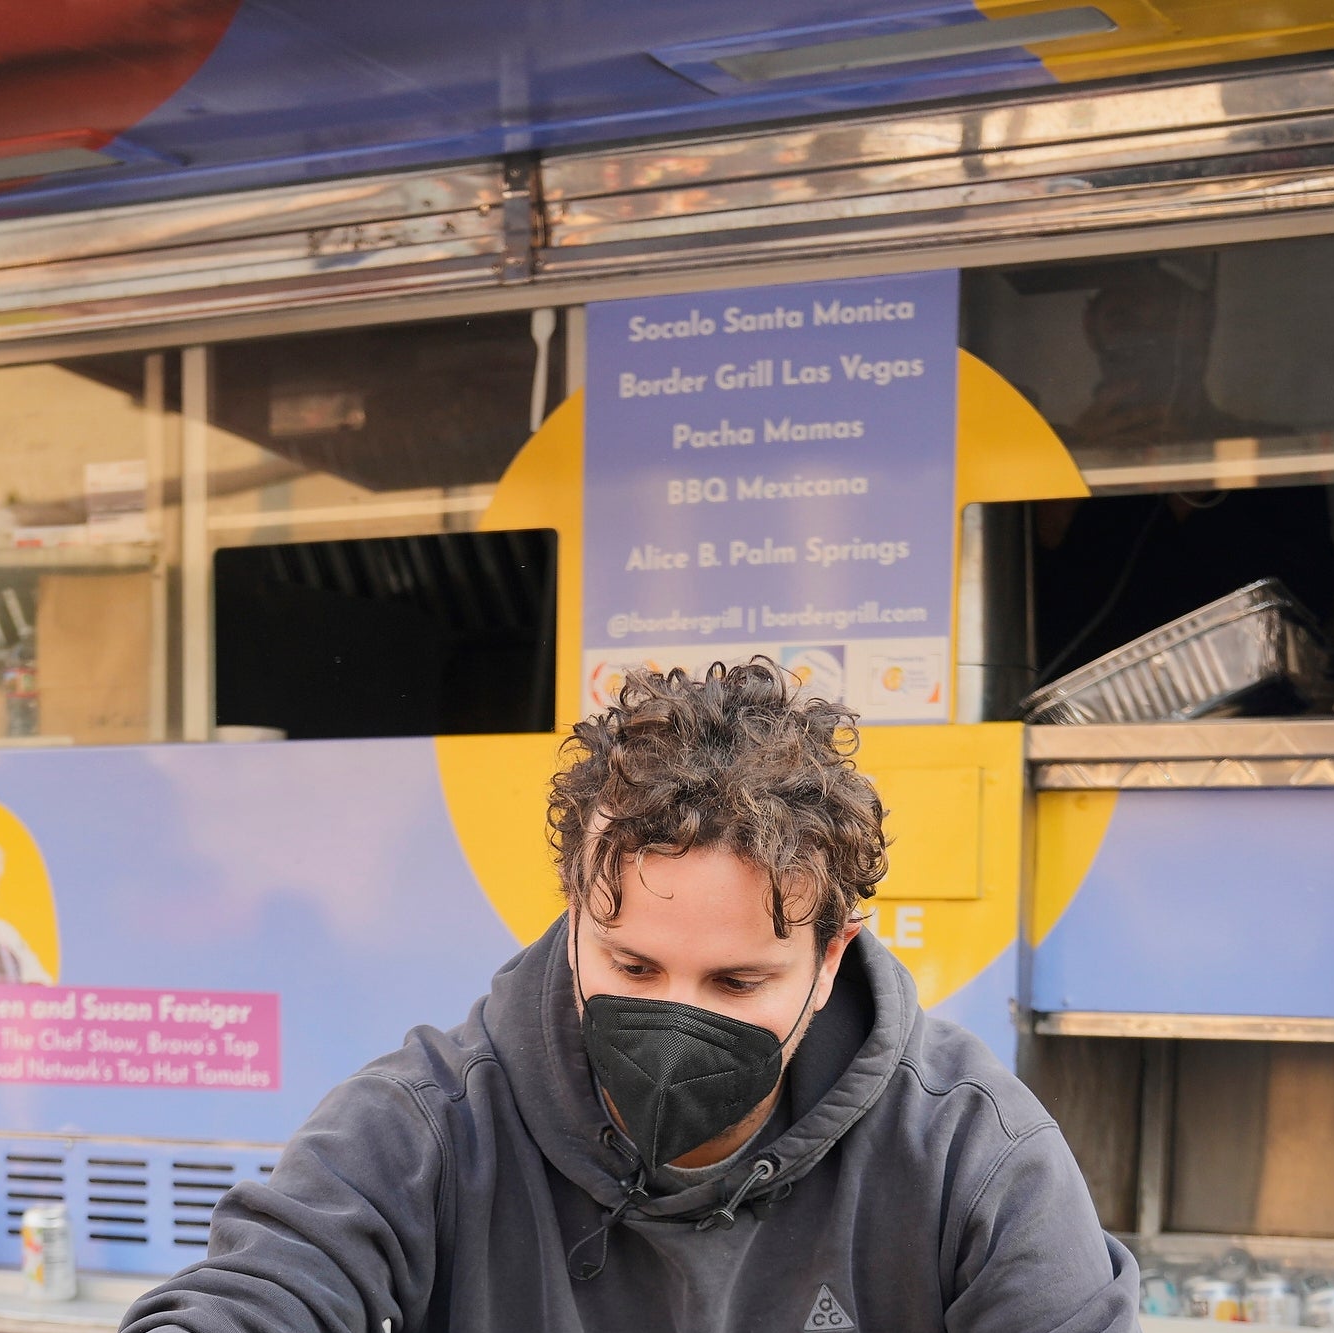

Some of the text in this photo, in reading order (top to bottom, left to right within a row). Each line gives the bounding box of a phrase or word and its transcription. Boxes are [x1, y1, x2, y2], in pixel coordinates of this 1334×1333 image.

[629, 298, 915, 342] Socalo Santa Monica
[619, 354, 924, 398] Border Grill Las Vegas
[672, 416, 864, 449] Pacha Mamas
[667, 475, 868, 504] BBQ Mexicana
[625, 537, 909, 571] Alice B. Palm Springs
[607, 606, 743, 638] @bordergrill
[762, 601, 927, 629] bordergrill.com
[30, 991, 76, 1020] and
[82, 992, 153, 1022] Susan
[158, 994, 253, 1030] Feniger
[1, 1027, 34, 1050] The
[39, 1027, 83, 1051] Chef
[222, 1032, 259, 1060] Top
[153, 1060, 189, 1084] Hot
